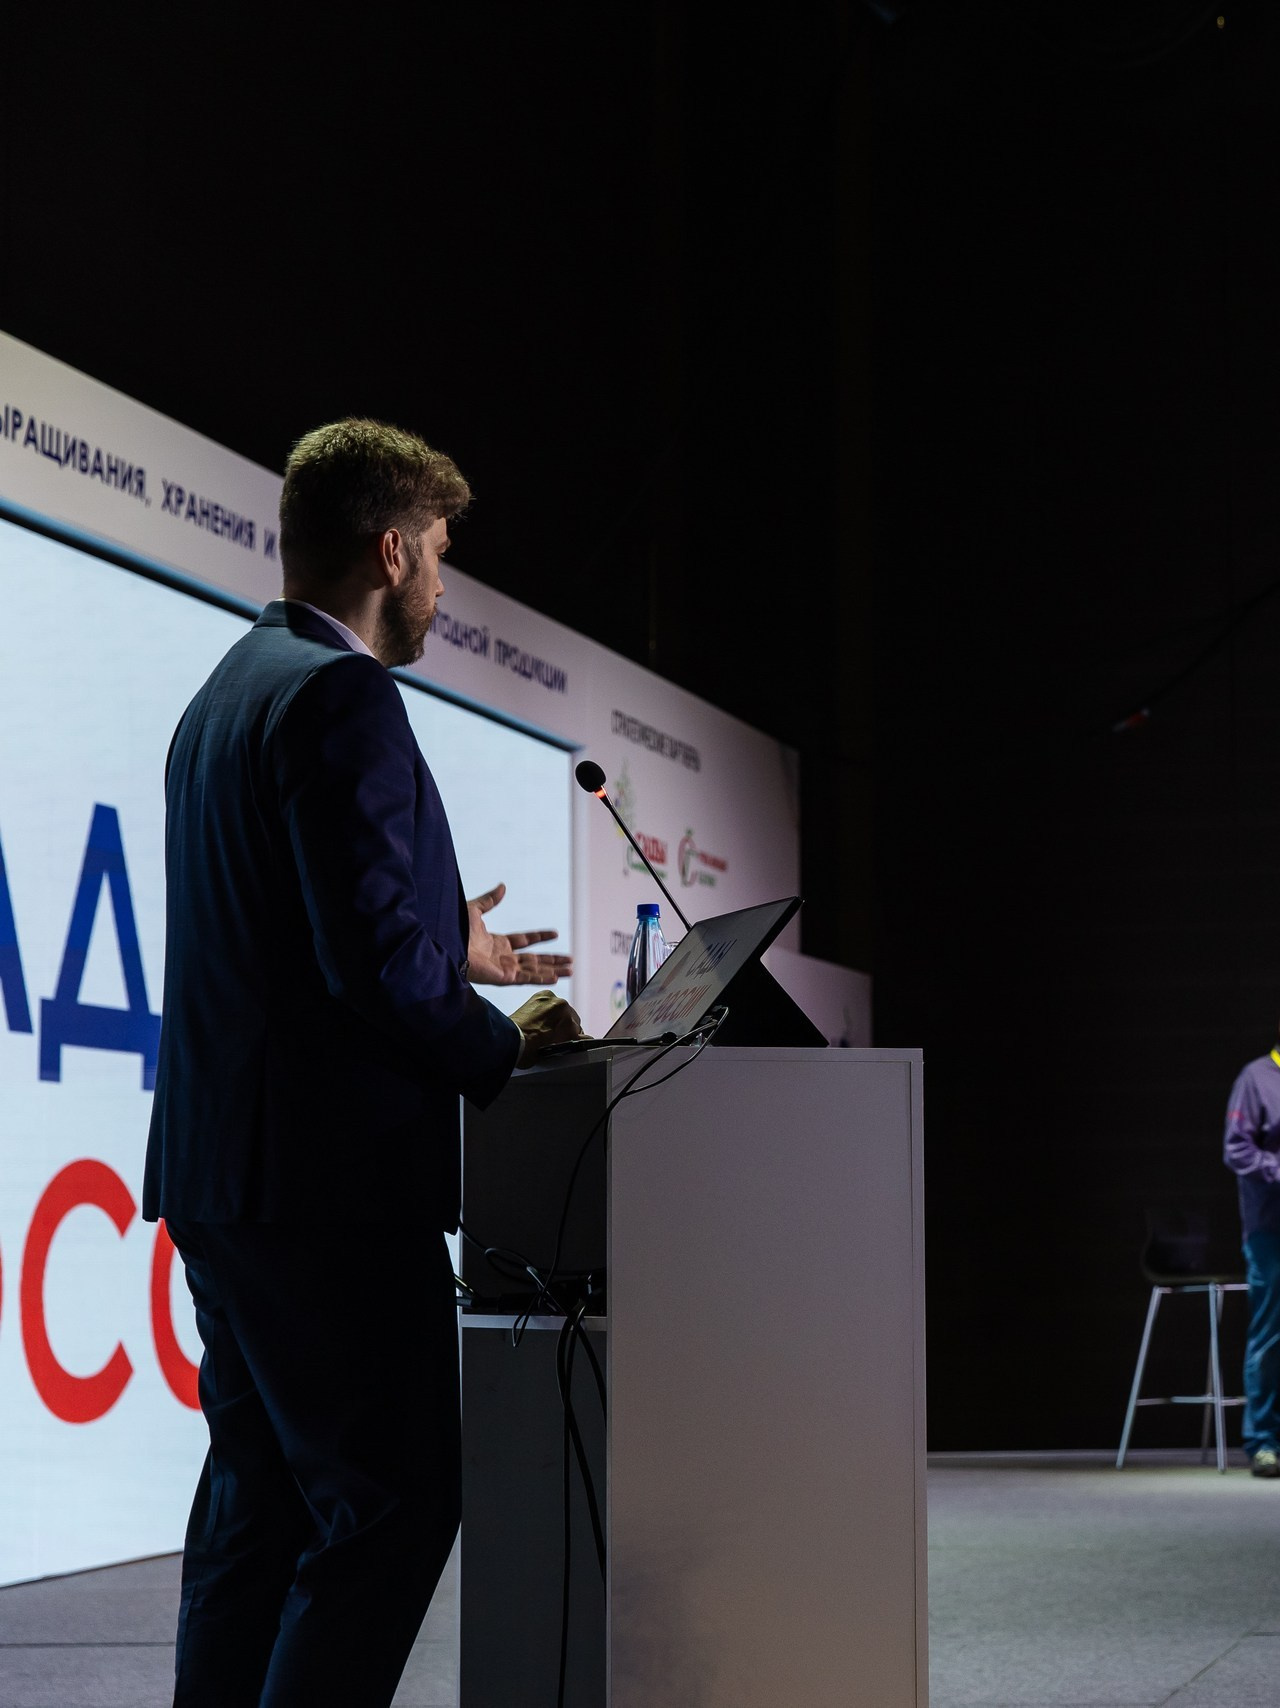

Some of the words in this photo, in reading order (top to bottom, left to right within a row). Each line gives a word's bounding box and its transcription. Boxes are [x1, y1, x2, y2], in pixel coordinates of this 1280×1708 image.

[161, 477, 257, 551] ХРАНЕНИЯ
[429, 609, 490, 659] ГОДНОЙ
[494, 637, 567, 693] ПРОДУКЦИИ
